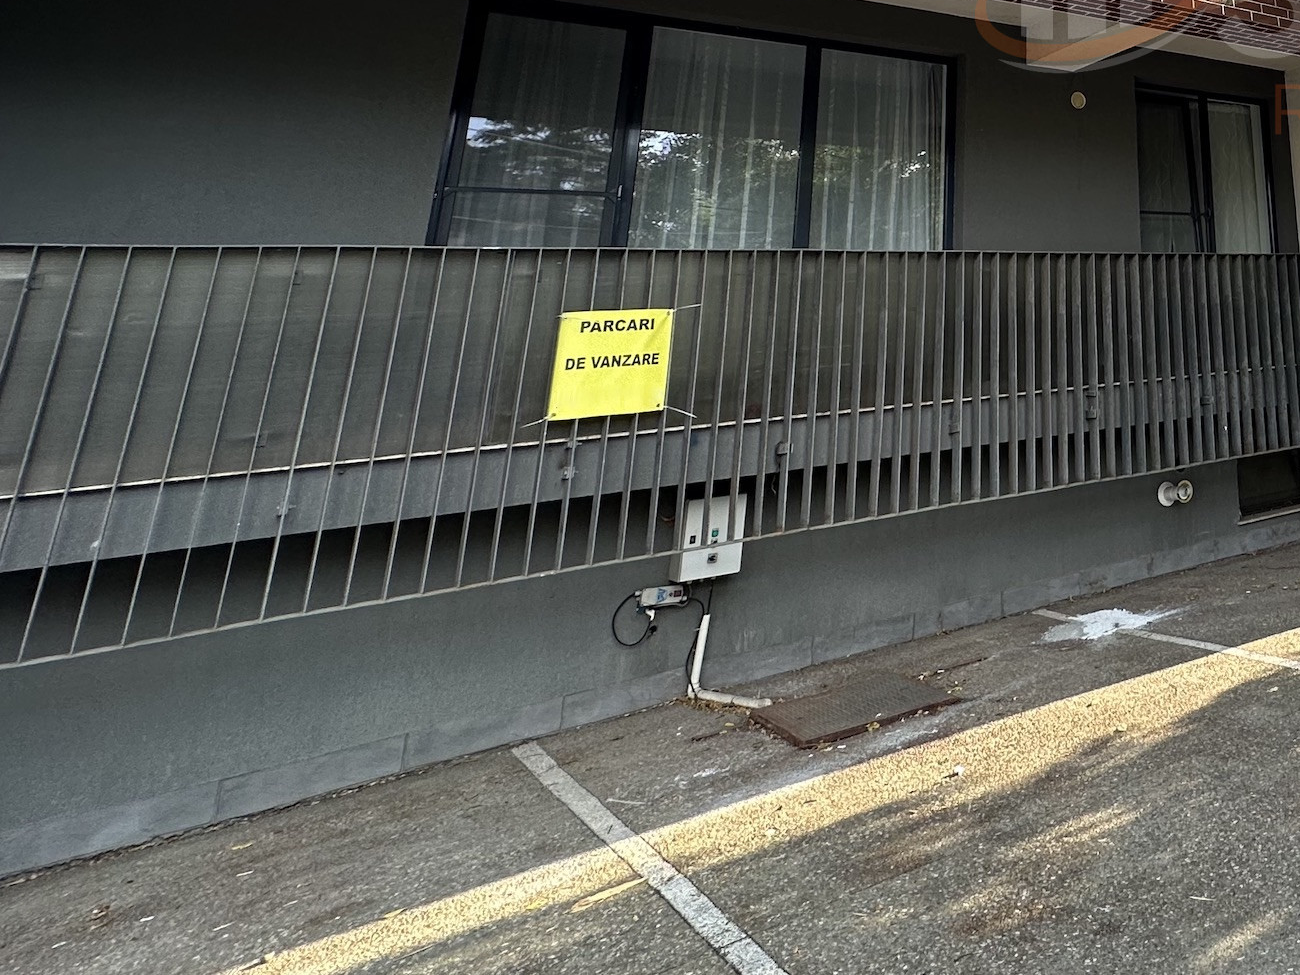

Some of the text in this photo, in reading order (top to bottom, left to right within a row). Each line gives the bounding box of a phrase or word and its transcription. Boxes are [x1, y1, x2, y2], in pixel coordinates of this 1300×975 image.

[580, 318, 655, 333] PARCARI
[565, 353, 660, 370] DE VANZARE
